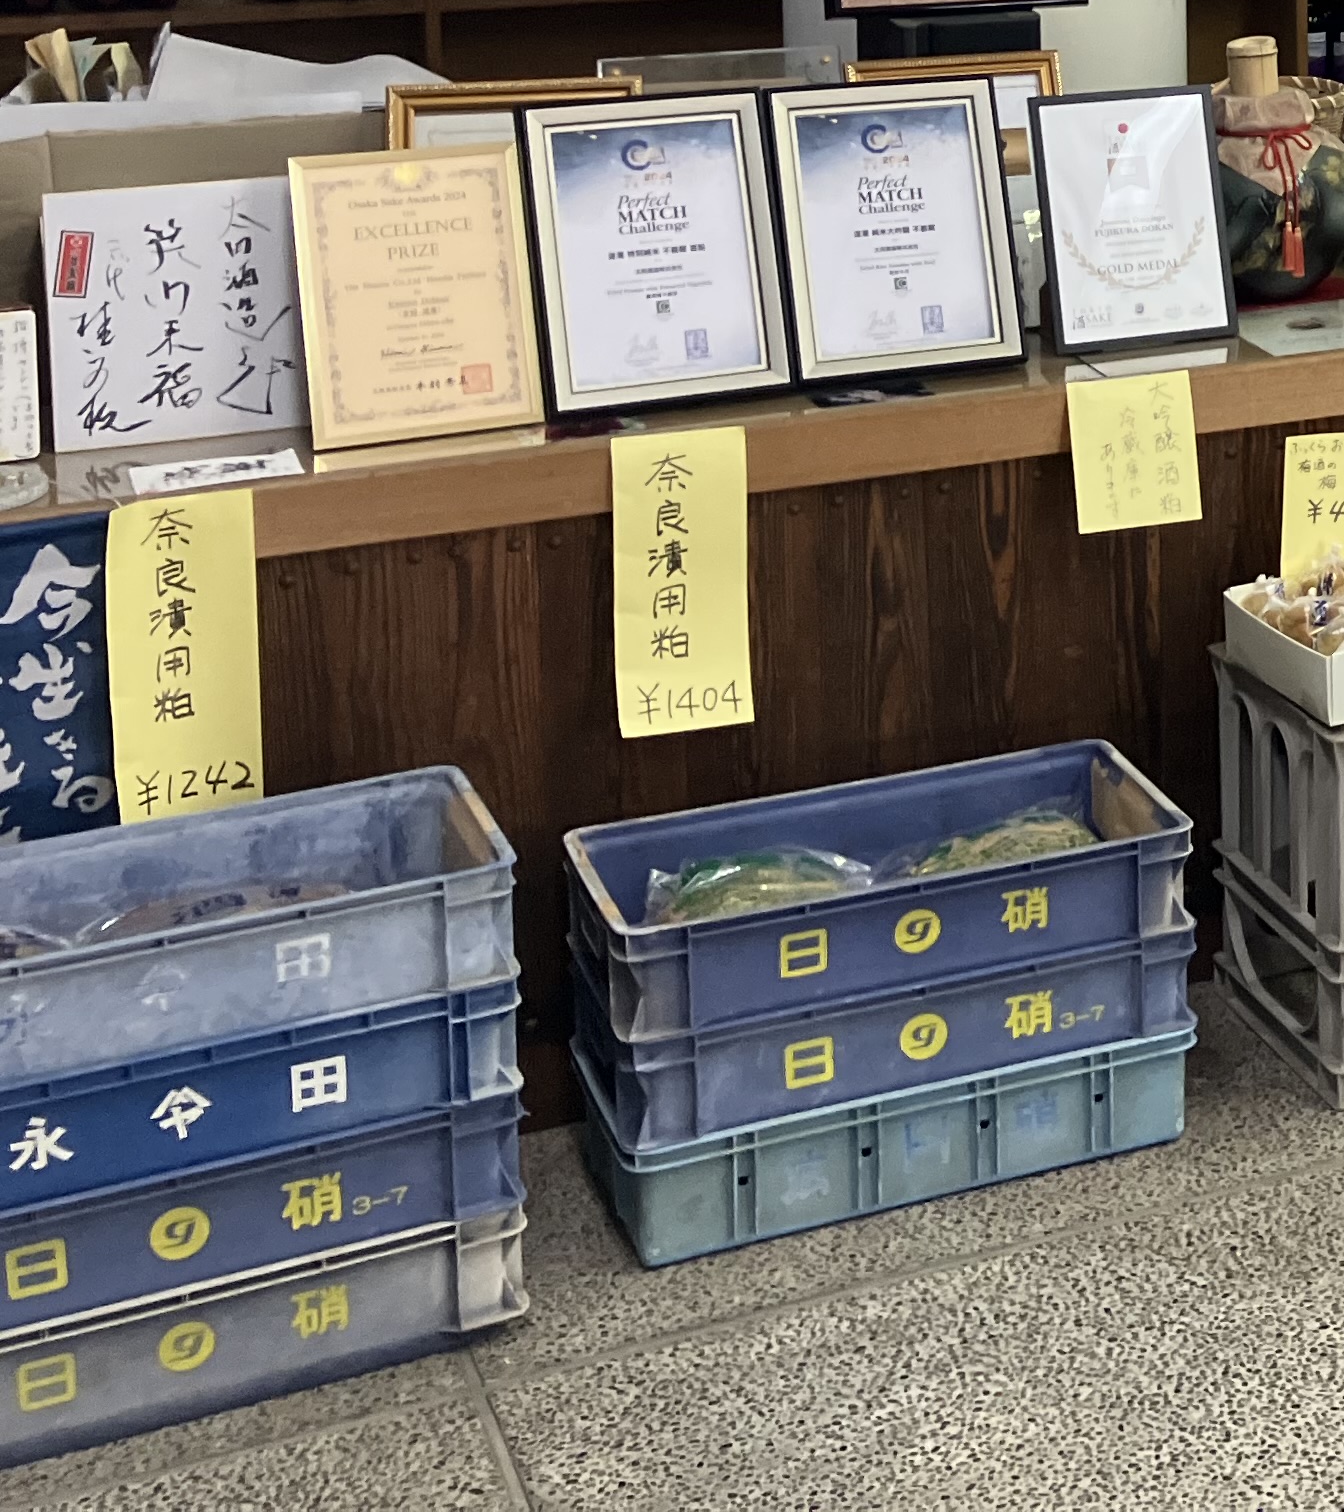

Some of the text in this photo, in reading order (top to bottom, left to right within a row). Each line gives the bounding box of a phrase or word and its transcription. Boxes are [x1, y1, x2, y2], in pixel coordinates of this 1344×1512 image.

[857, 174, 908, 191] Perfect
[407, 194, 440, 205] Awards
[617, 192, 671, 210] Perfect
[858, 187, 923, 205] MATCH
[618, 205, 687, 224] MATCH
[858, 202, 926, 216] Challenge
[353, 216, 472, 241] EXCELLENCE
[618, 221, 690, 235] Challenge
[1094, 226, 1139, 238] FUJIKURA
[387, 242, 440, 260] PRIZE
[1097, 257, 1180, 275] GOLD MEDAL
[637, 680, 743, 725] ¥1404
[136, 760, 256, 816] ¥1242
[779, 928, 828, 979] 日
[1001, 886, 1049, 934] 硝
[784, 1036, 835, 1090] 日
[1004, 990, 1053, 1039] 硝
[9, 1055, 348, 1172] 永 田
[5, 1238, 69, 1299] 日
[282, 1171, 343, 1230] 硝
[16, 1352, 77, 1411] 日
[291, 1284, 349, 1338] 硝
